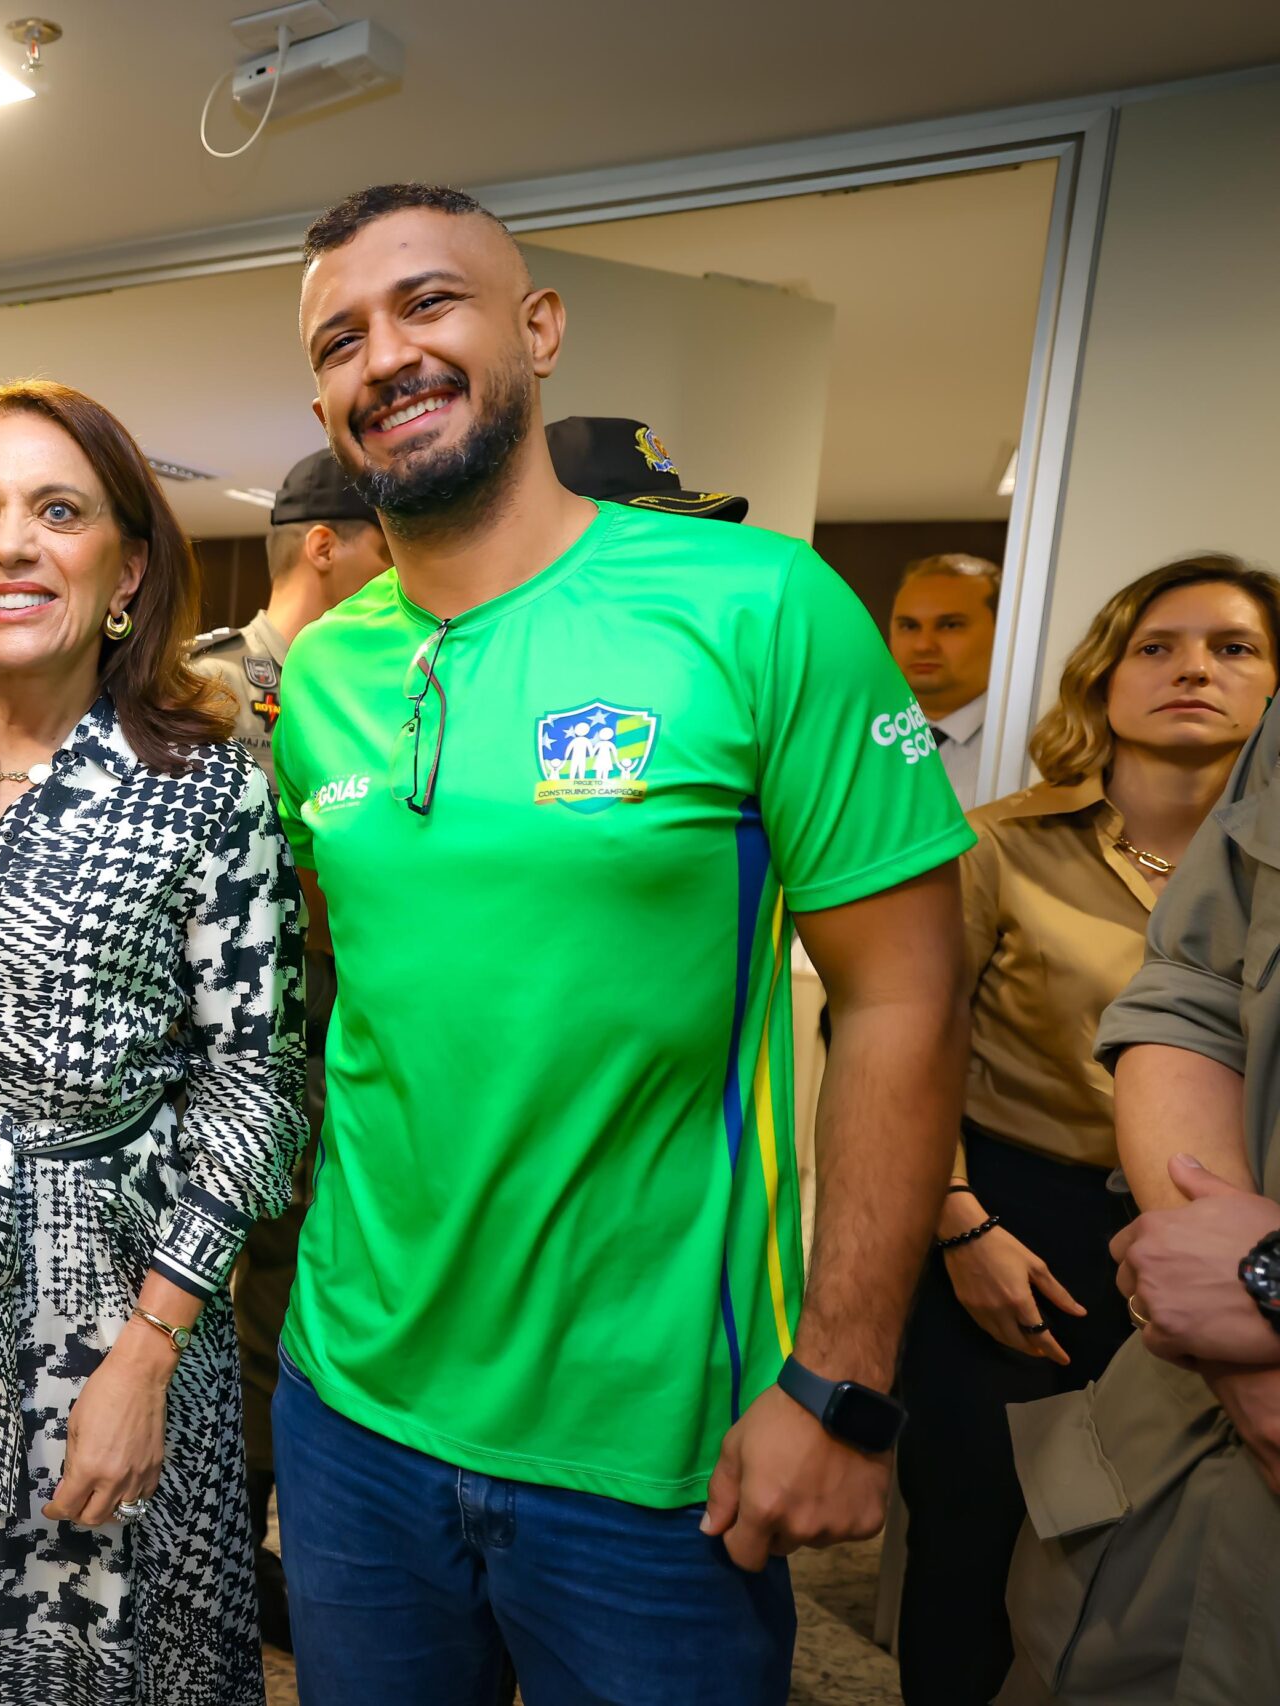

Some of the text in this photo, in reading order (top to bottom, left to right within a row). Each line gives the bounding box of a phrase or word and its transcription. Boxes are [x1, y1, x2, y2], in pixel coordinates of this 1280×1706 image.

[254, 702, 280, 713] ROTA
[318, 774, 372, 807] GOIÁS
[538, 787, 644, 798] CONSTRUINDO CAMPEÕES
